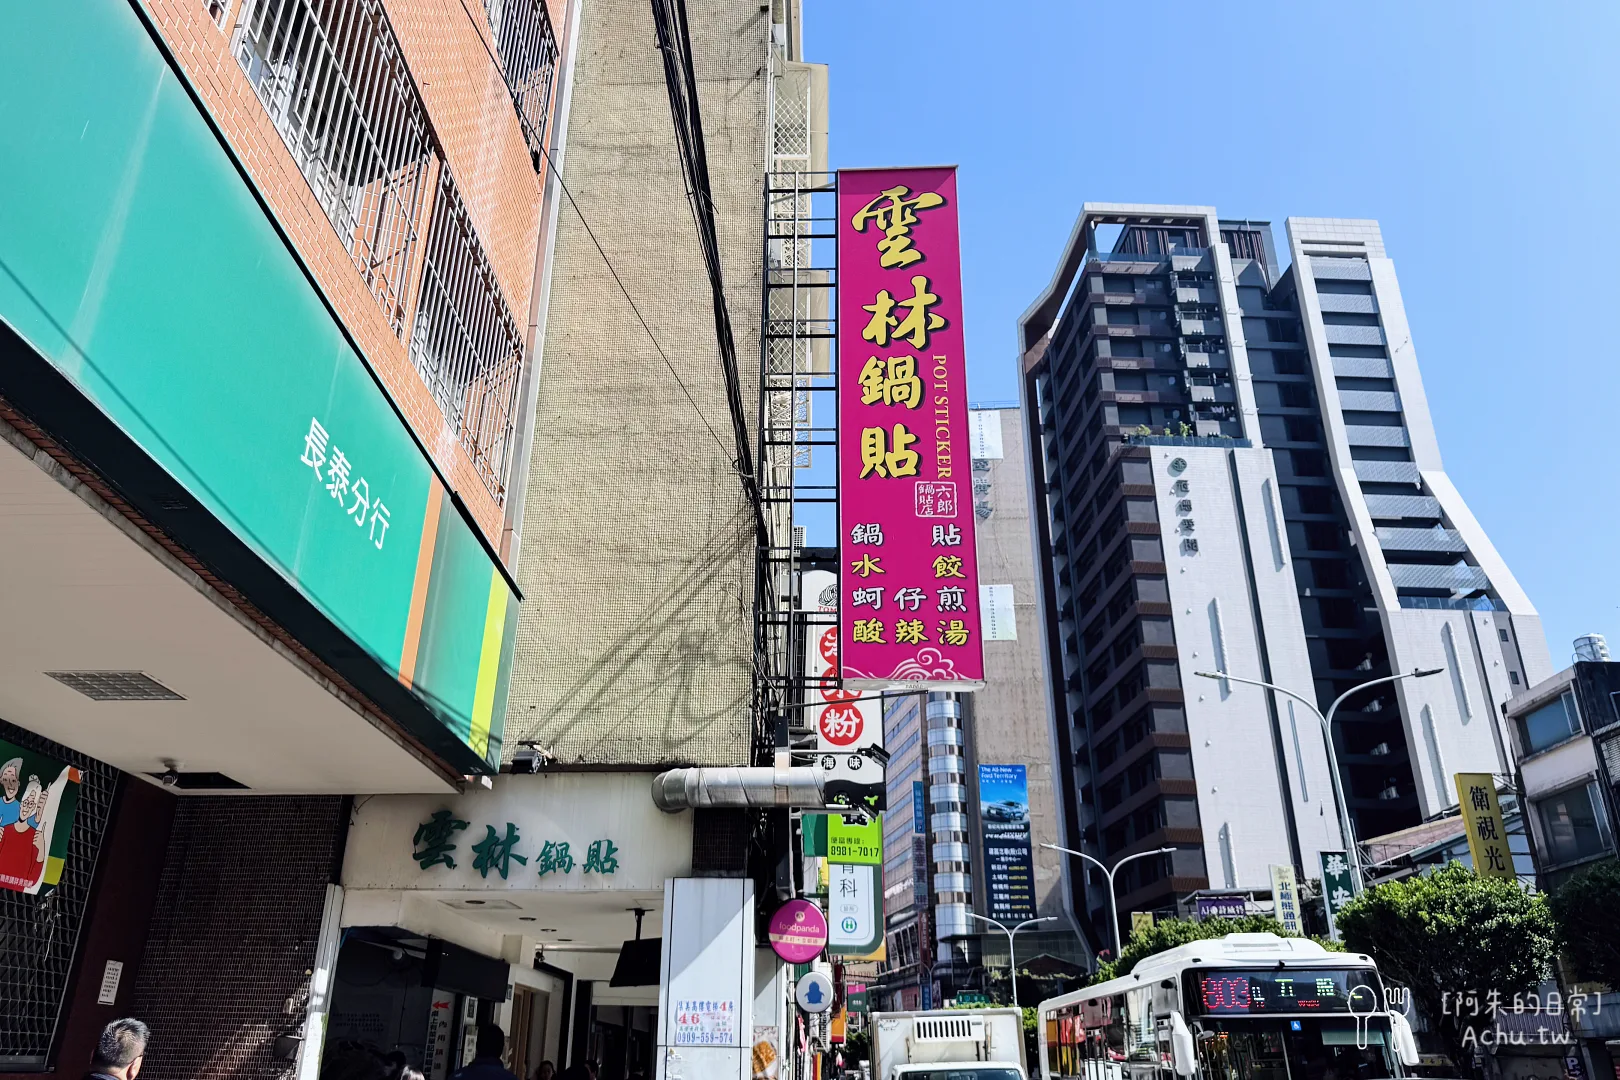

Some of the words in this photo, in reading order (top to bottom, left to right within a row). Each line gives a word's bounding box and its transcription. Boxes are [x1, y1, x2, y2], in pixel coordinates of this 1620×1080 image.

[850, 184, 947, 480] 雲林鍋貼
[932, 354, 948, 391] POT
[933, 395, 953, 479] STICKER
[300, 416, 391, 550] 長泰分行
[918, 484, 935, 516] 鍋貼店
[935, 485, 954, 515] 六郎
[850, 523, 961, 547] 鍋貼
[851, 554, 966, 579] 水餃
[852, 586, 967, 612] 蚵仔煎
[852, 618, 970, 646] 酸辣湯
[1470, 785, 1506, 872] 衛視光
[412, 810, 619, 879] 雲林鍋貼
[830, 846, 879, 857] 8981-7017
[1325, 854, 1353, 911] 華安
[779, 922, 820, 933] foodpanda
[677, 1032, 733, 1043] 0909-559-574
